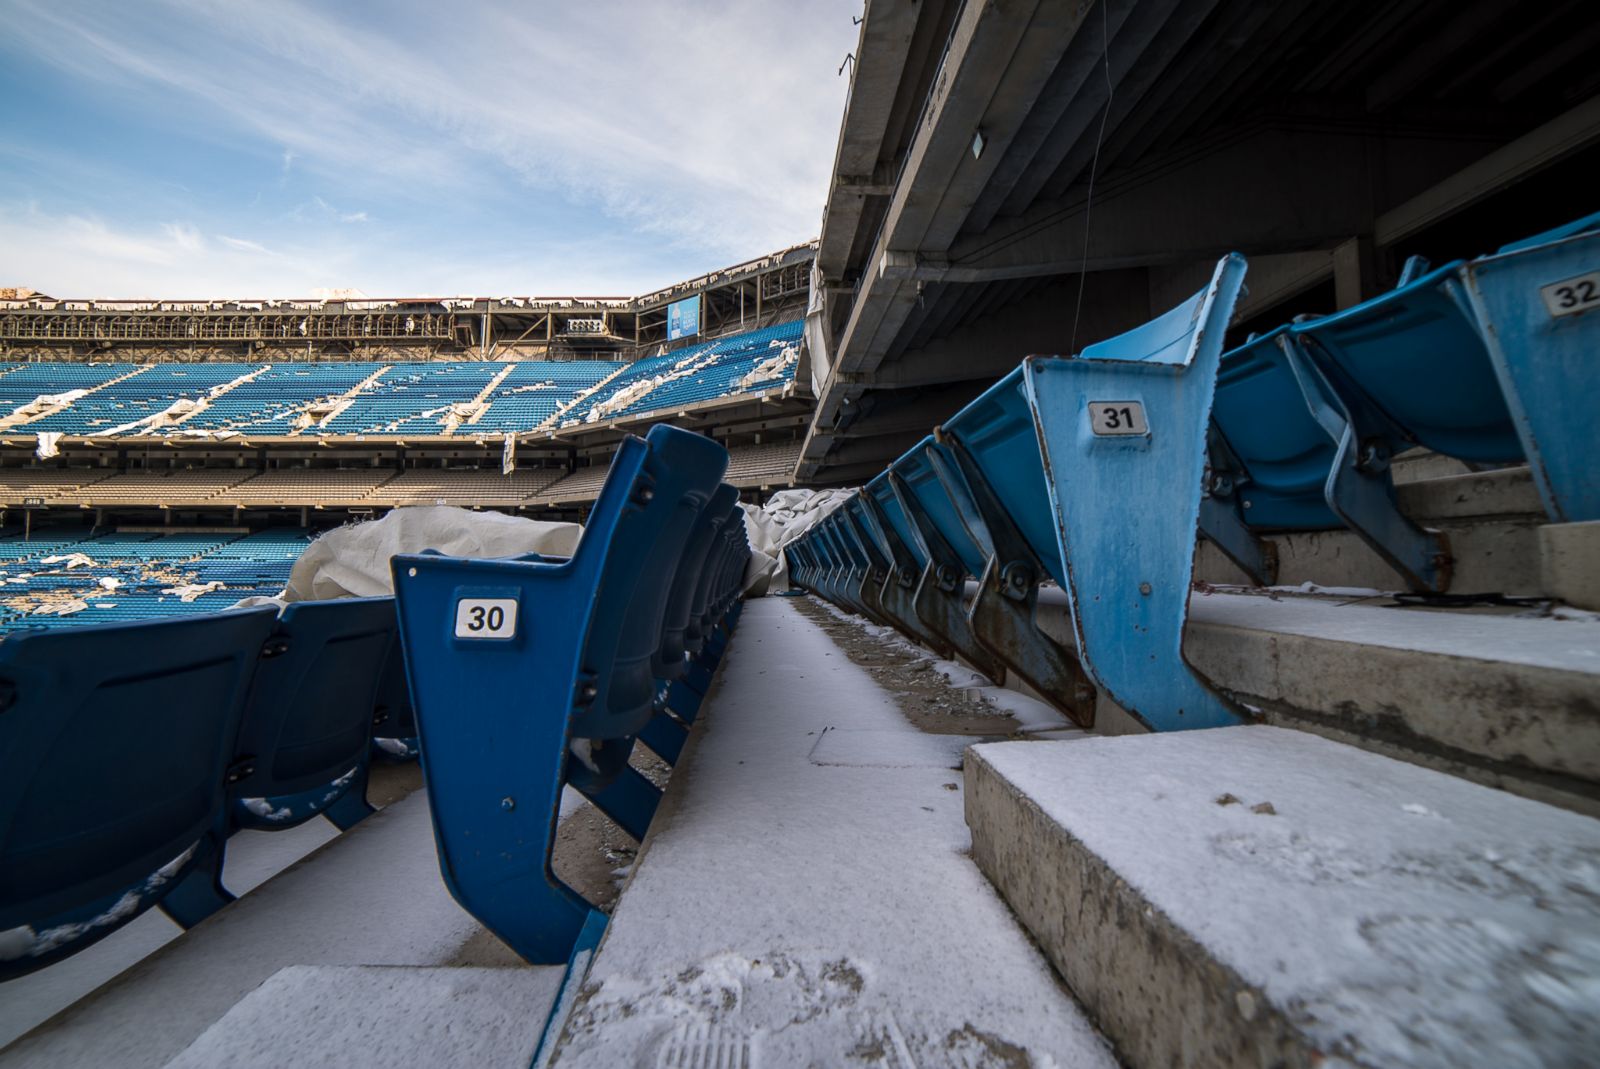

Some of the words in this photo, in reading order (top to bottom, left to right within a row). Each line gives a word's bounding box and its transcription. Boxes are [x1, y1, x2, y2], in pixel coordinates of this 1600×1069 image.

[1554, 281, 1600, 308] 32
[1103, 407, 1134, 429] 31
[467, 605, 504, 631] 30
